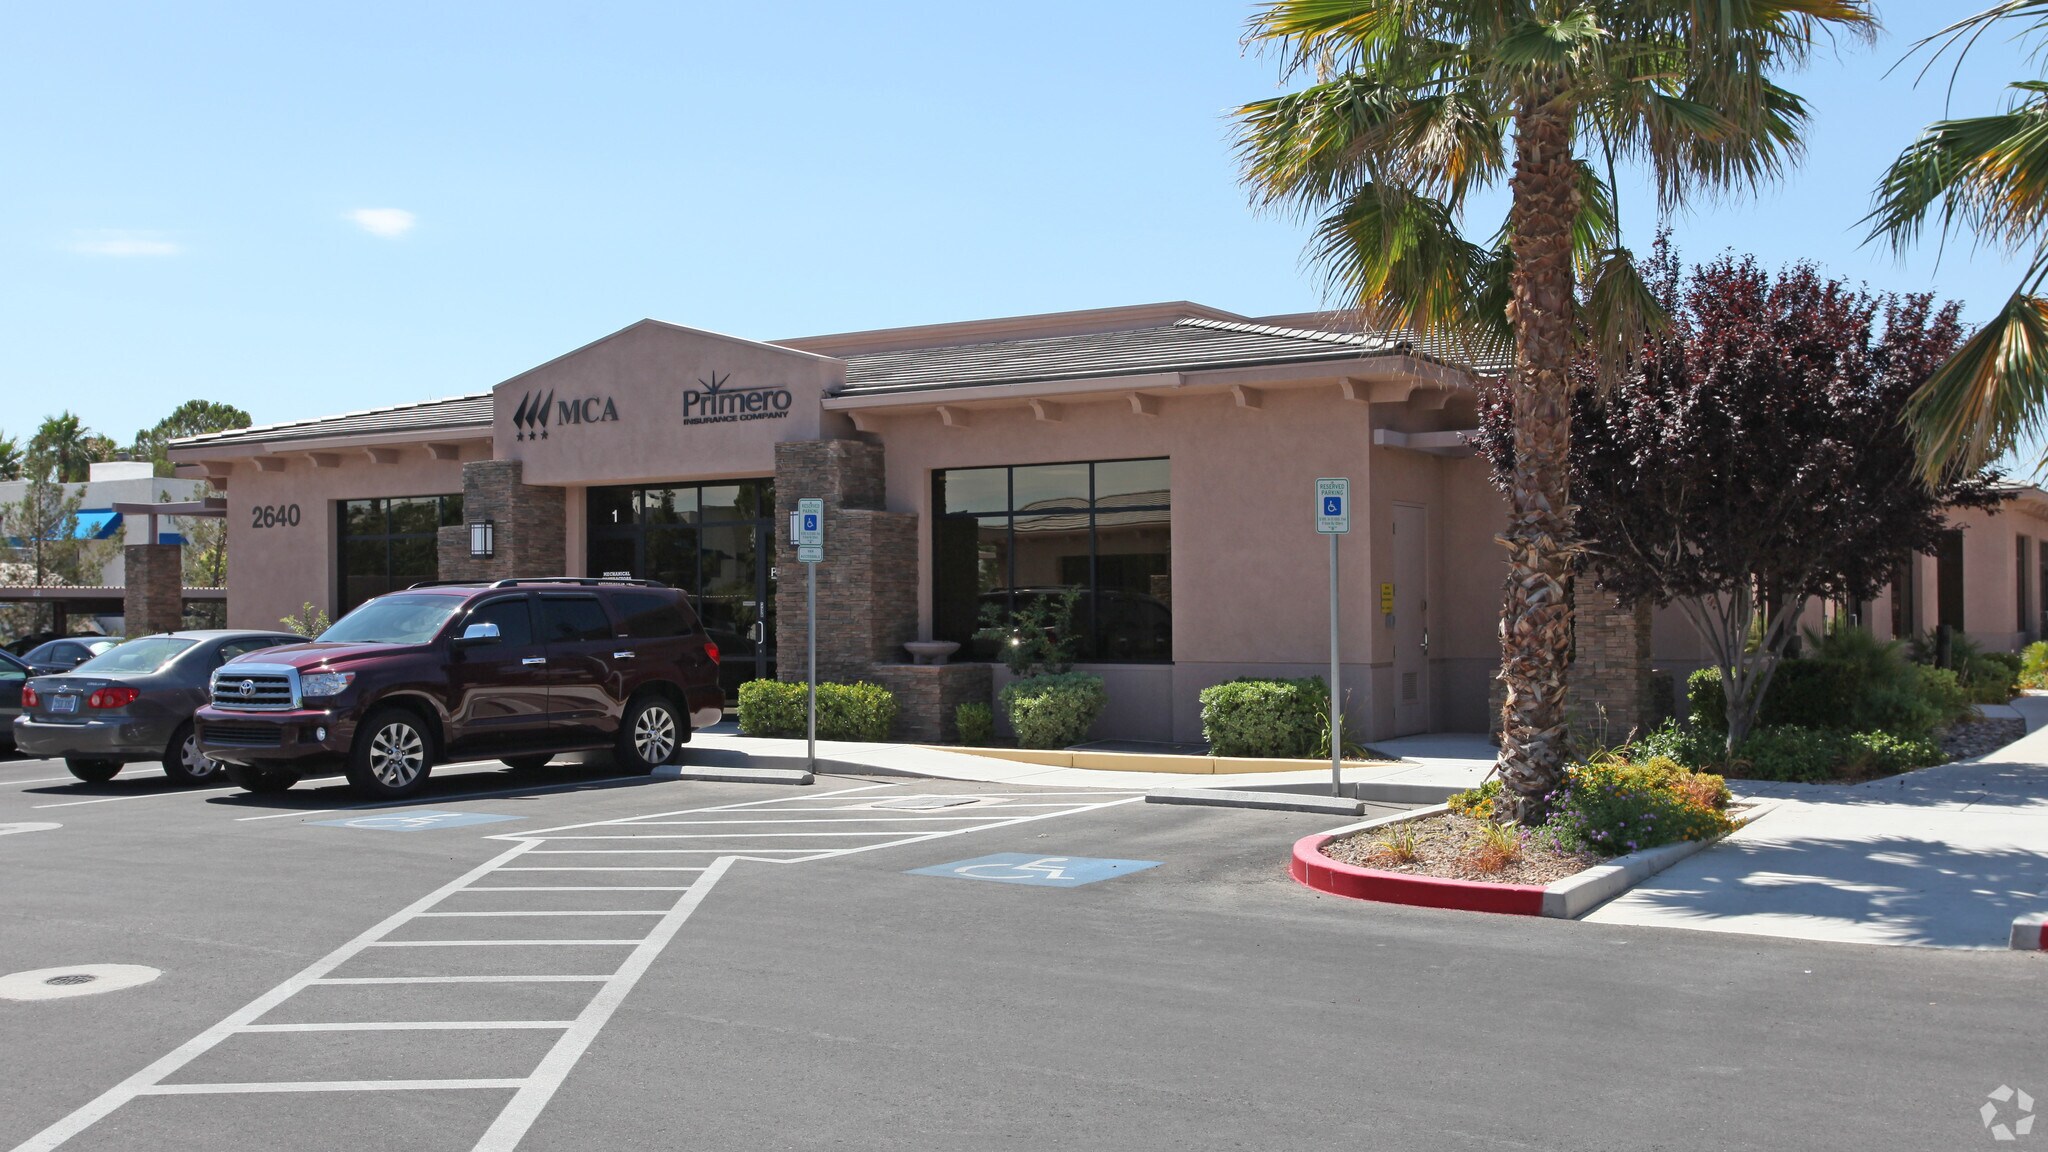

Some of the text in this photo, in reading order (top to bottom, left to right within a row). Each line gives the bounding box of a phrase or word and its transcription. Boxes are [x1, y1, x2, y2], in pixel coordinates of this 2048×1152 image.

[557, 396, 620, 426] MCA
[683, 389, 792, 417] Primero
[683, 410, 789, 425] INSURANCE COMPANY
[252, 504, 301, 528] 2640
[612, 509, 618, 523] 1
